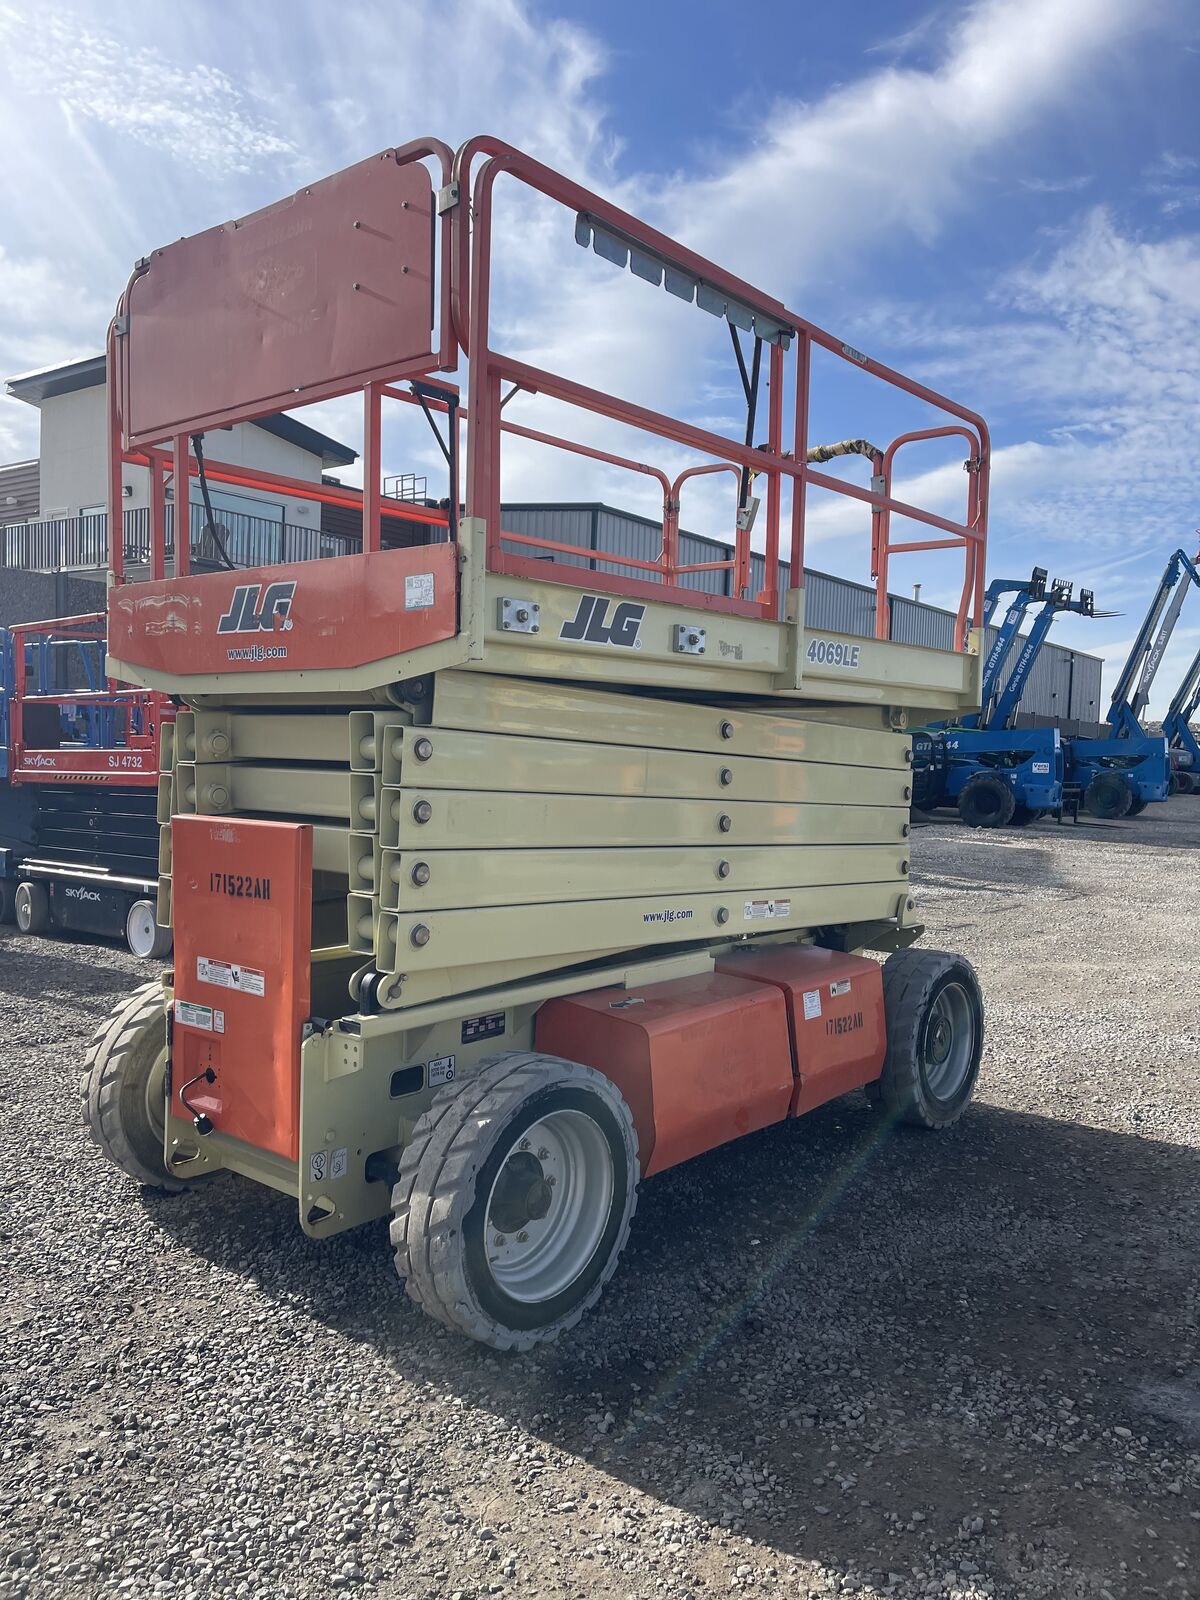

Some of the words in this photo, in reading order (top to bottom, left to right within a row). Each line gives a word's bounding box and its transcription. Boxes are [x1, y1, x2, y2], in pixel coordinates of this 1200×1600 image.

[217, 581, 296, 634] JLG
[559, 594, 647, 648] JLG
[227, 645, 287, 661] www.jlg.com
[807, 639, 860, 668] 4069LE
[988, 637, 1005, 668] GTH-844
[1009, 675, 1020, 692] Genie
[1017, 644, 1034, 674] GTH-844
[24, 754, 56, 767] SKYJACK
[108, 756, 119, 767] SJ
[121, 756, 142, 767] 4732
[65, 886, 101, 901] SKYJACK
[210, 872, 271, 900] 171522AH
[643, 910, 693, 922] www.jlg.com
